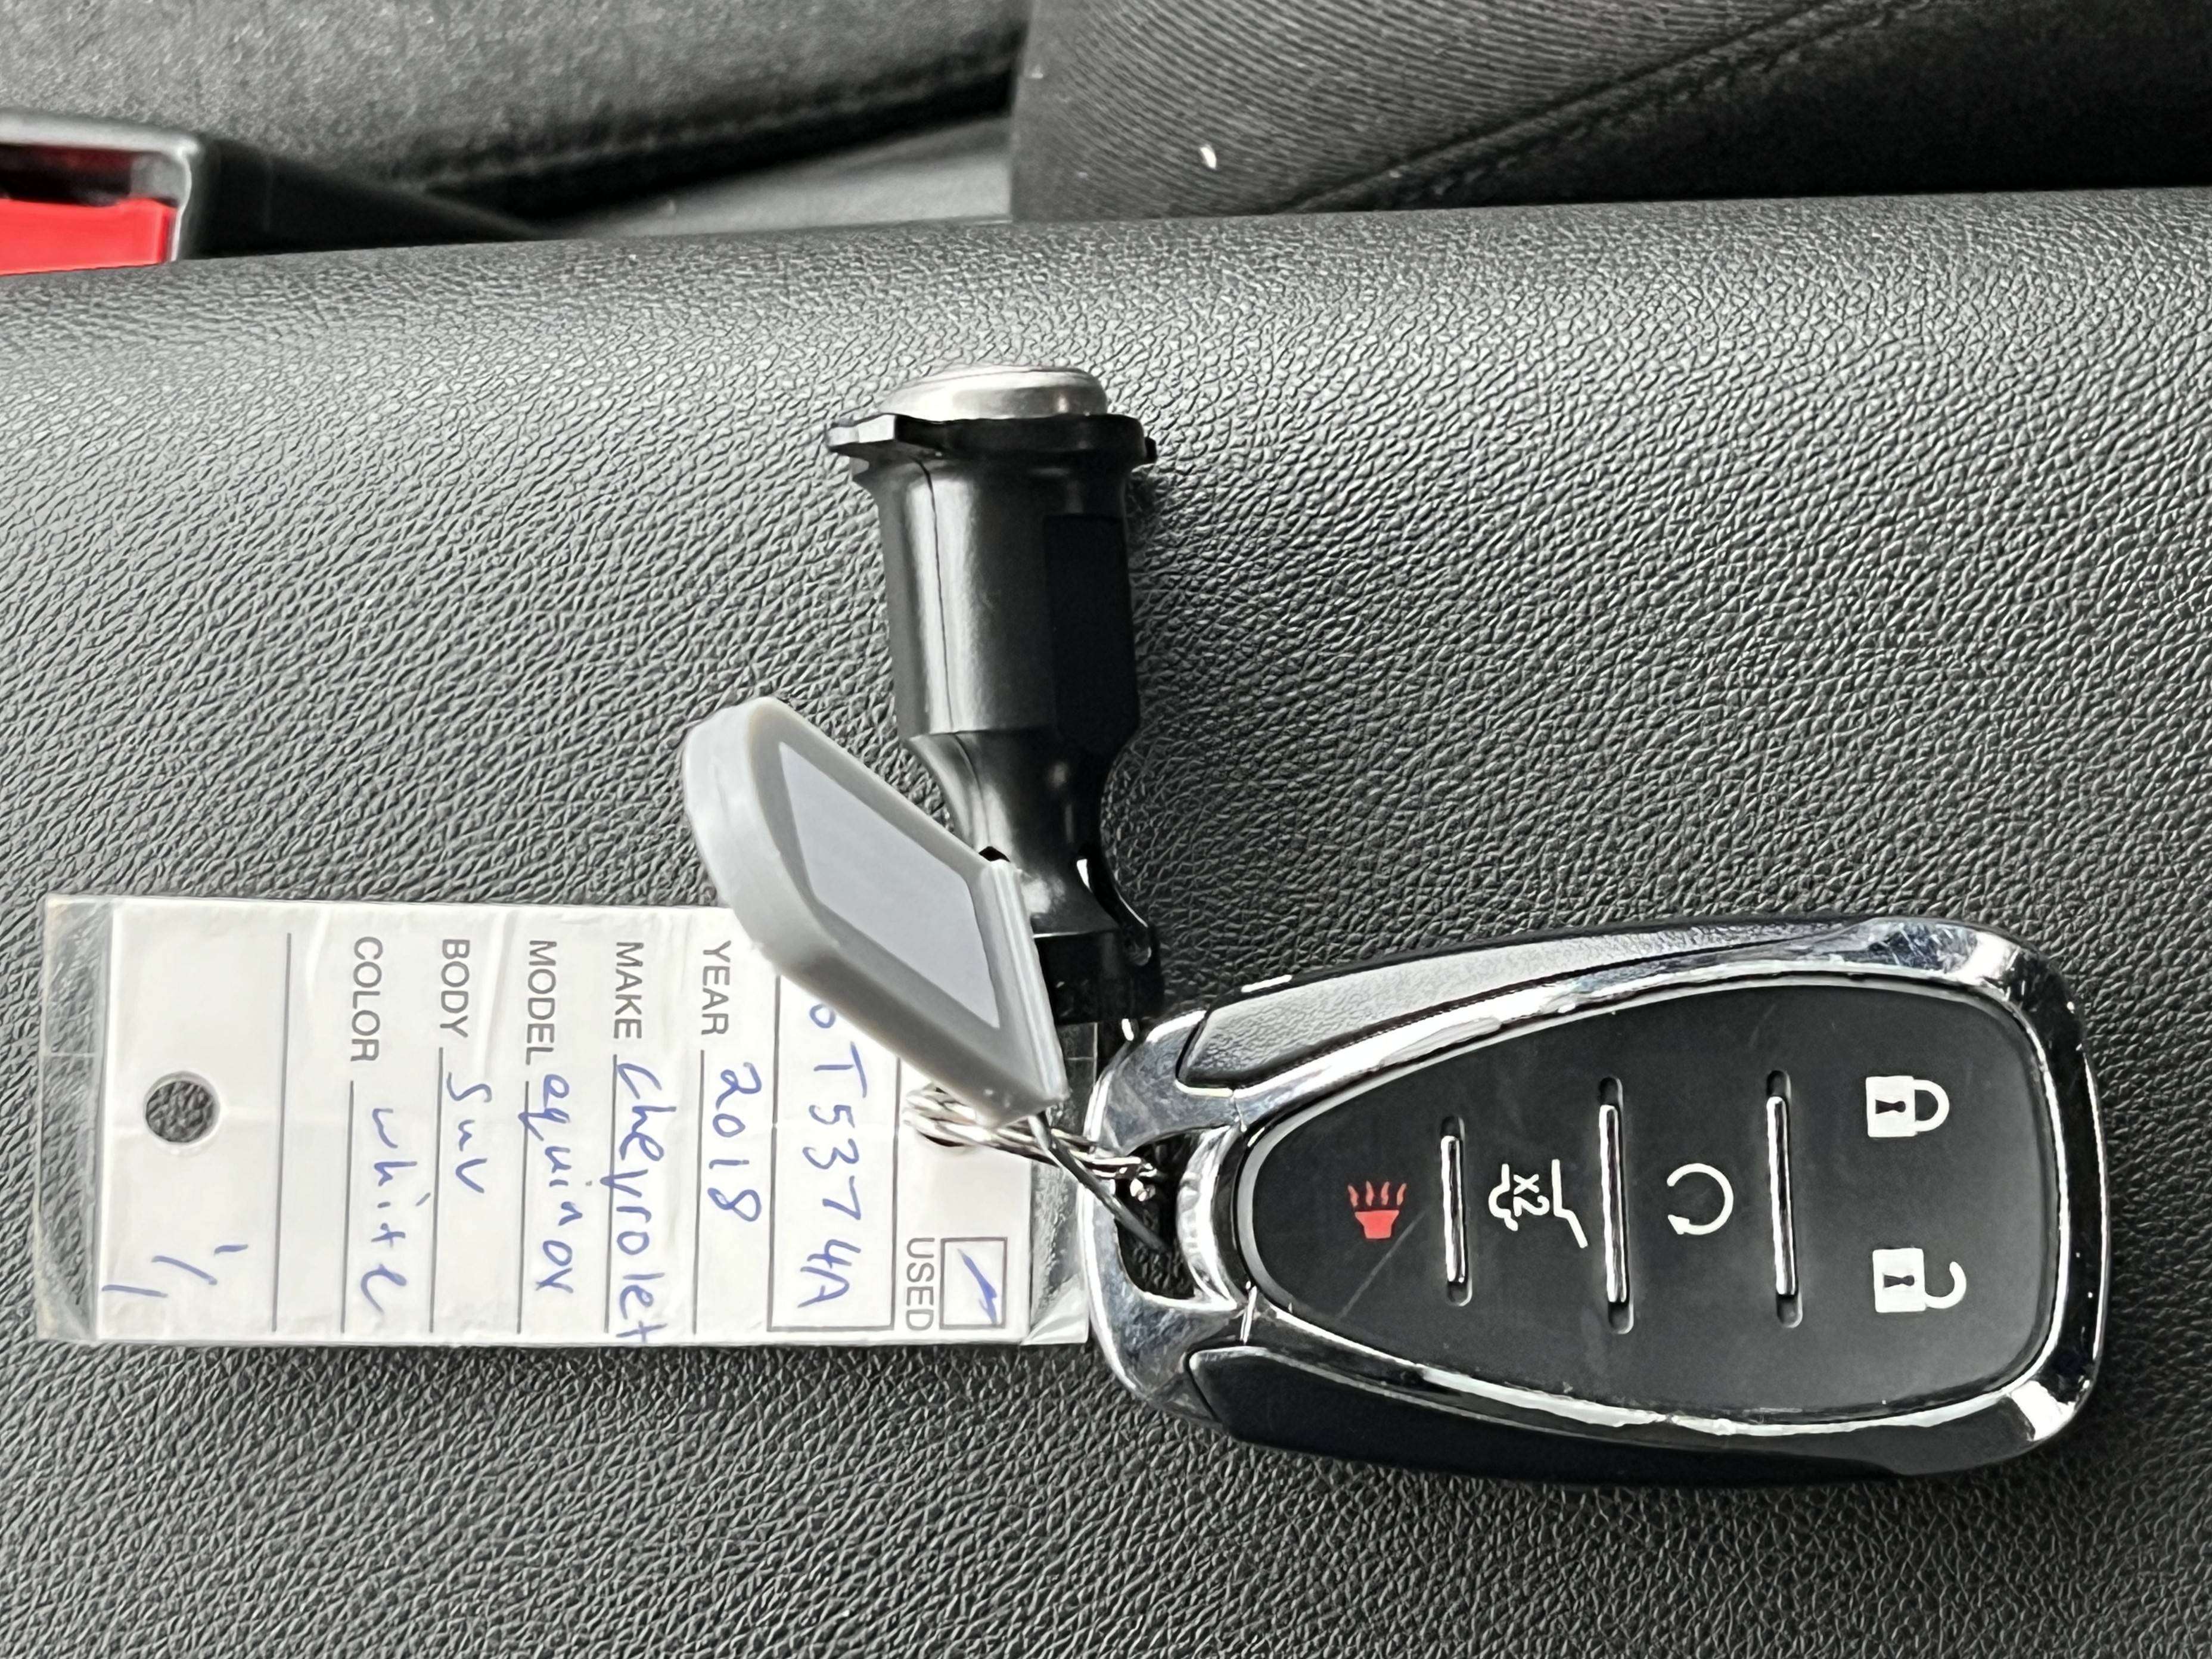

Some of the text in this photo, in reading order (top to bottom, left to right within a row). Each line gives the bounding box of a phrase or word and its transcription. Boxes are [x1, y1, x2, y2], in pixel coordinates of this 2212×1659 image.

[350, 936, 384, 1062] COLOR
[439, 938, 471, 1038] BODY
[525, 940, 557, 1065] MODEL
[613, 941, 645, 1039] MAKE
[700, 940, 732, 1036] YEAR
[707, 1062, 762, 1222] 2018
[905, 1237, 936, 1332] USED
